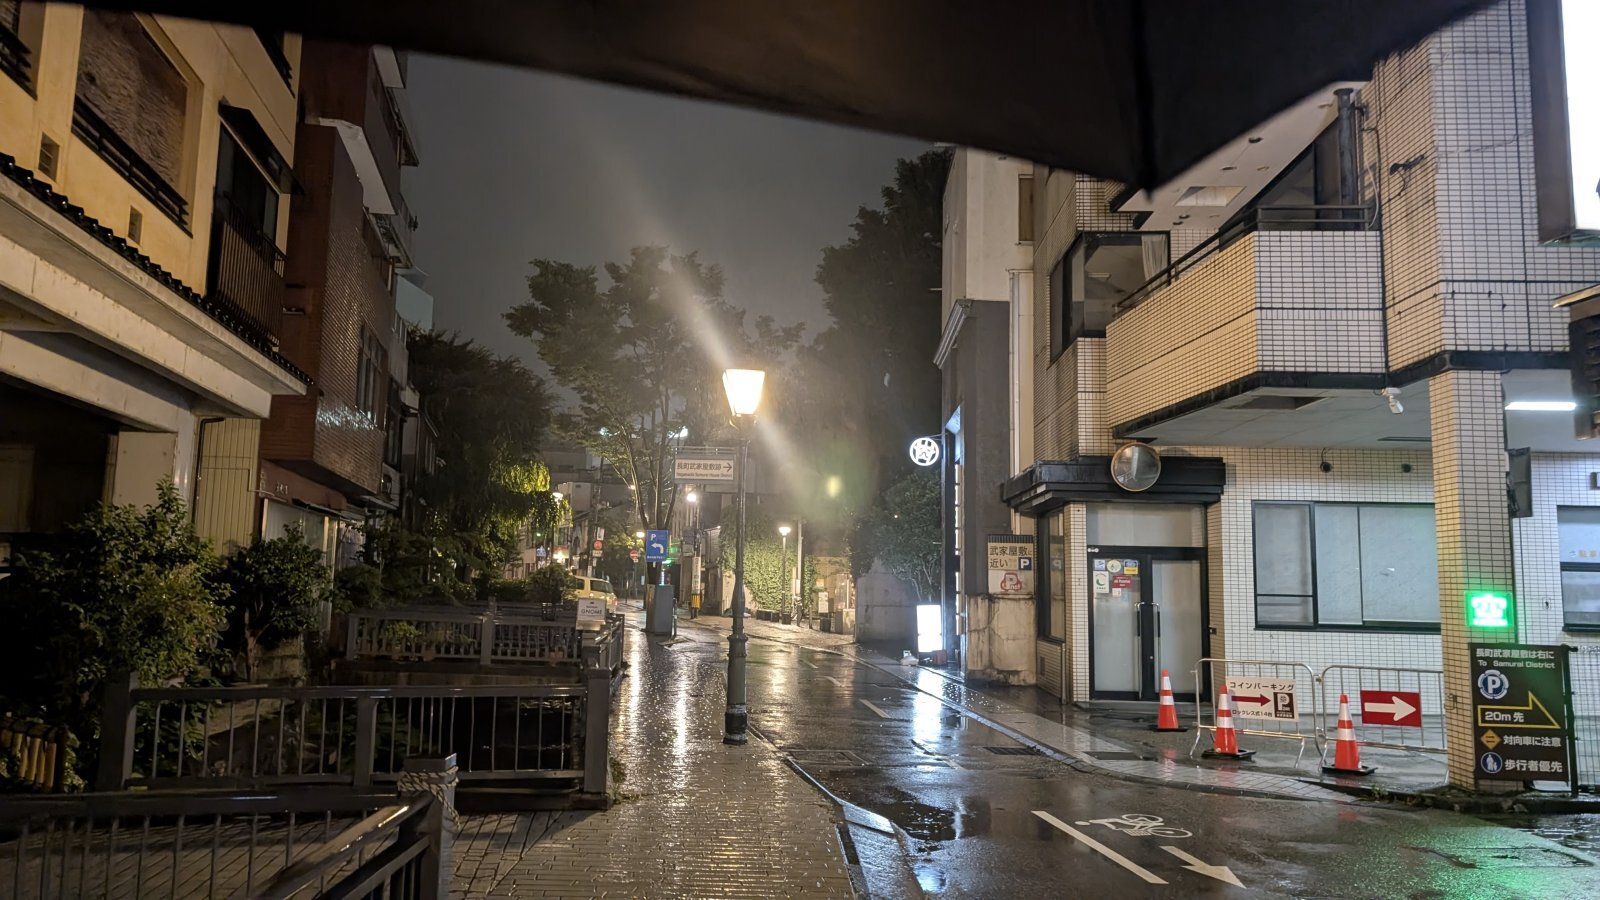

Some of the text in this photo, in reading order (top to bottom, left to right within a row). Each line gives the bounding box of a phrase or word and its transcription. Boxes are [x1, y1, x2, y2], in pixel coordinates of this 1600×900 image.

[677, 462, 721, 470] 長町武家屋敷跡
[989, 545, 1033, 556] 武家屋敷に
[989, 558, 1008, 568] 近い
[1476, 648, 1555, 659] 長町武家屋敷は右に
[1493, 660, 1524, 668] Samurai
[1525, 661, 1556, 669] District
[1229, 681, 1295, 692] コインパーキング
[1503, 734, 1562, 747] 対向車に注意
[1504, 759, 1563, 773] 歩行者優先
